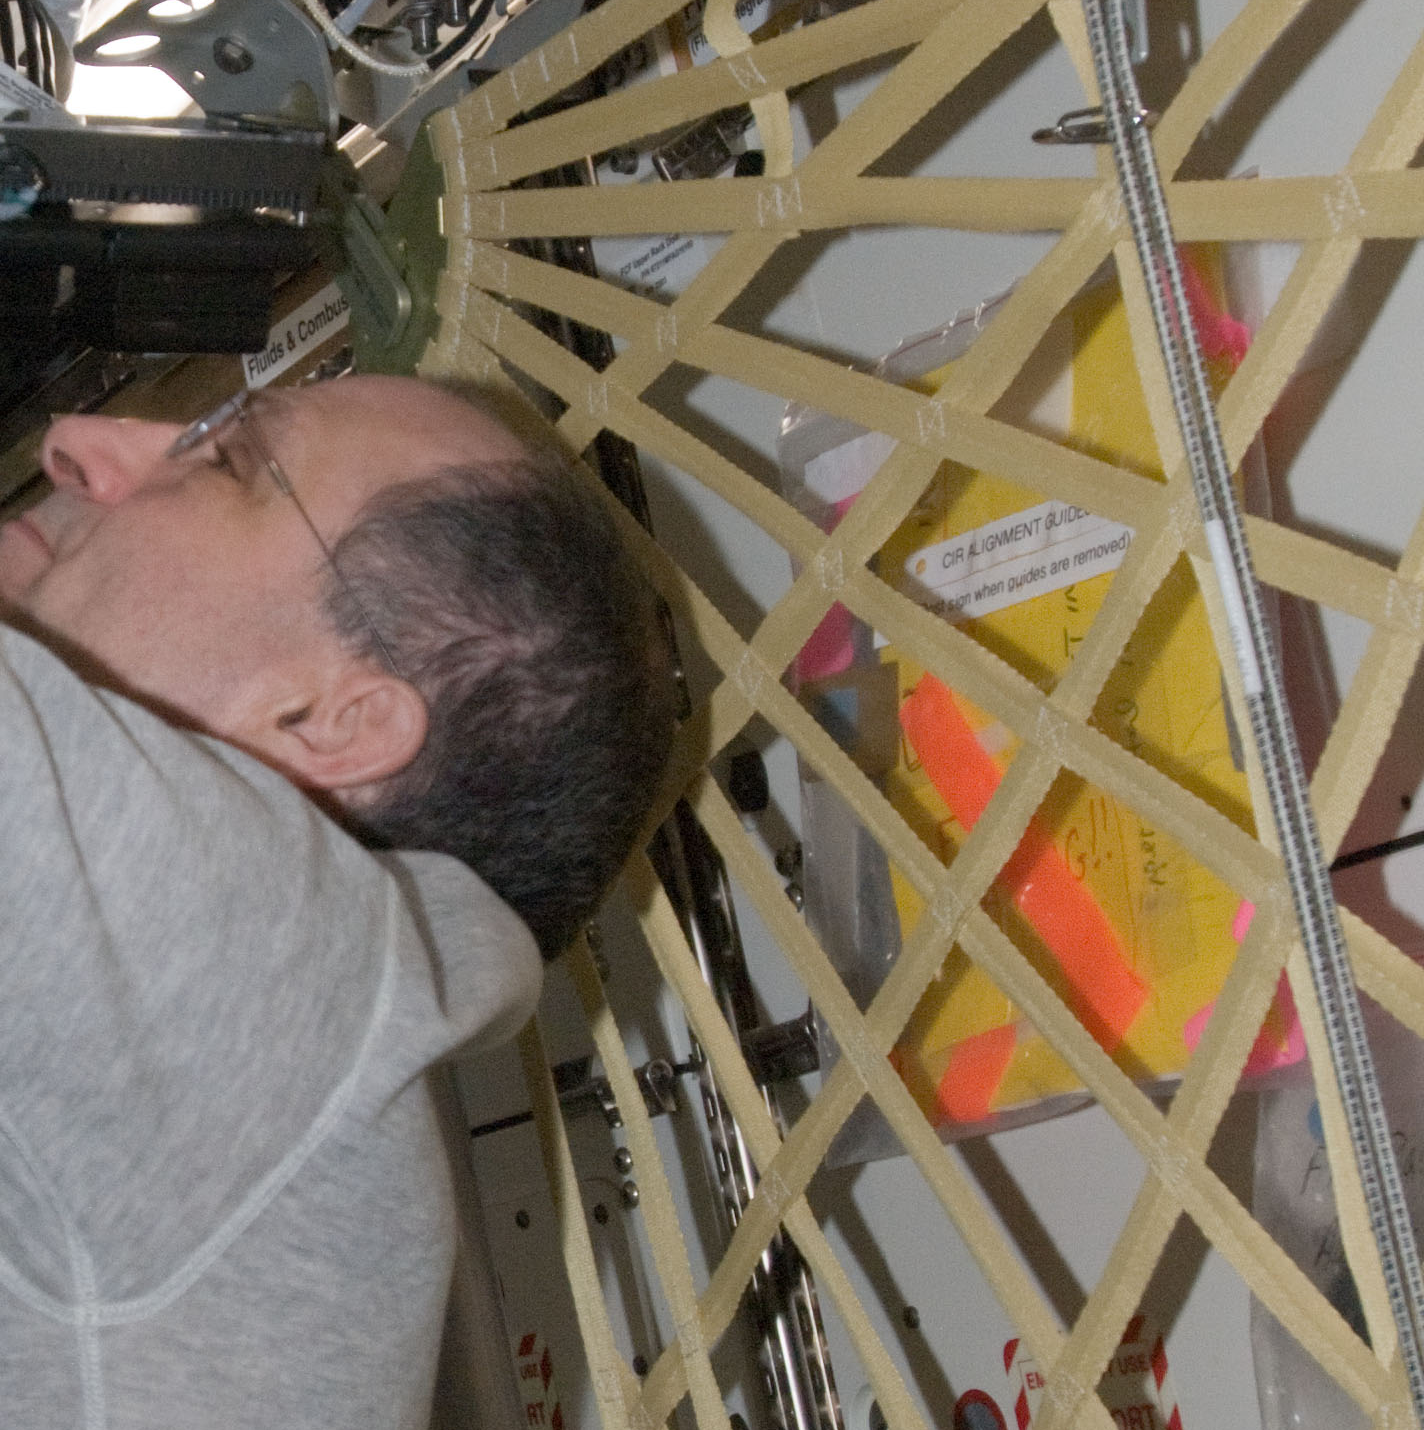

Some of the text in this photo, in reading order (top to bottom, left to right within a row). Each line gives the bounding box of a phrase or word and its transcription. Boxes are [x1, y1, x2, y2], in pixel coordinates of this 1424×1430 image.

[247, 296, 350, 381] Fluids & Combus
[942, 548, 964, 569] CIR
[967, 517, 1043, 557] ALIGNMENT
[948, 591, 972, 614] sign
[974, 580, 1005, 605] when
[1007, 566, 1048, 593] guides
[1049, 557, 1071, 575] are
[1072, 530, 1132, 567] removed)
[527, 1401, 546, 1427] RT
